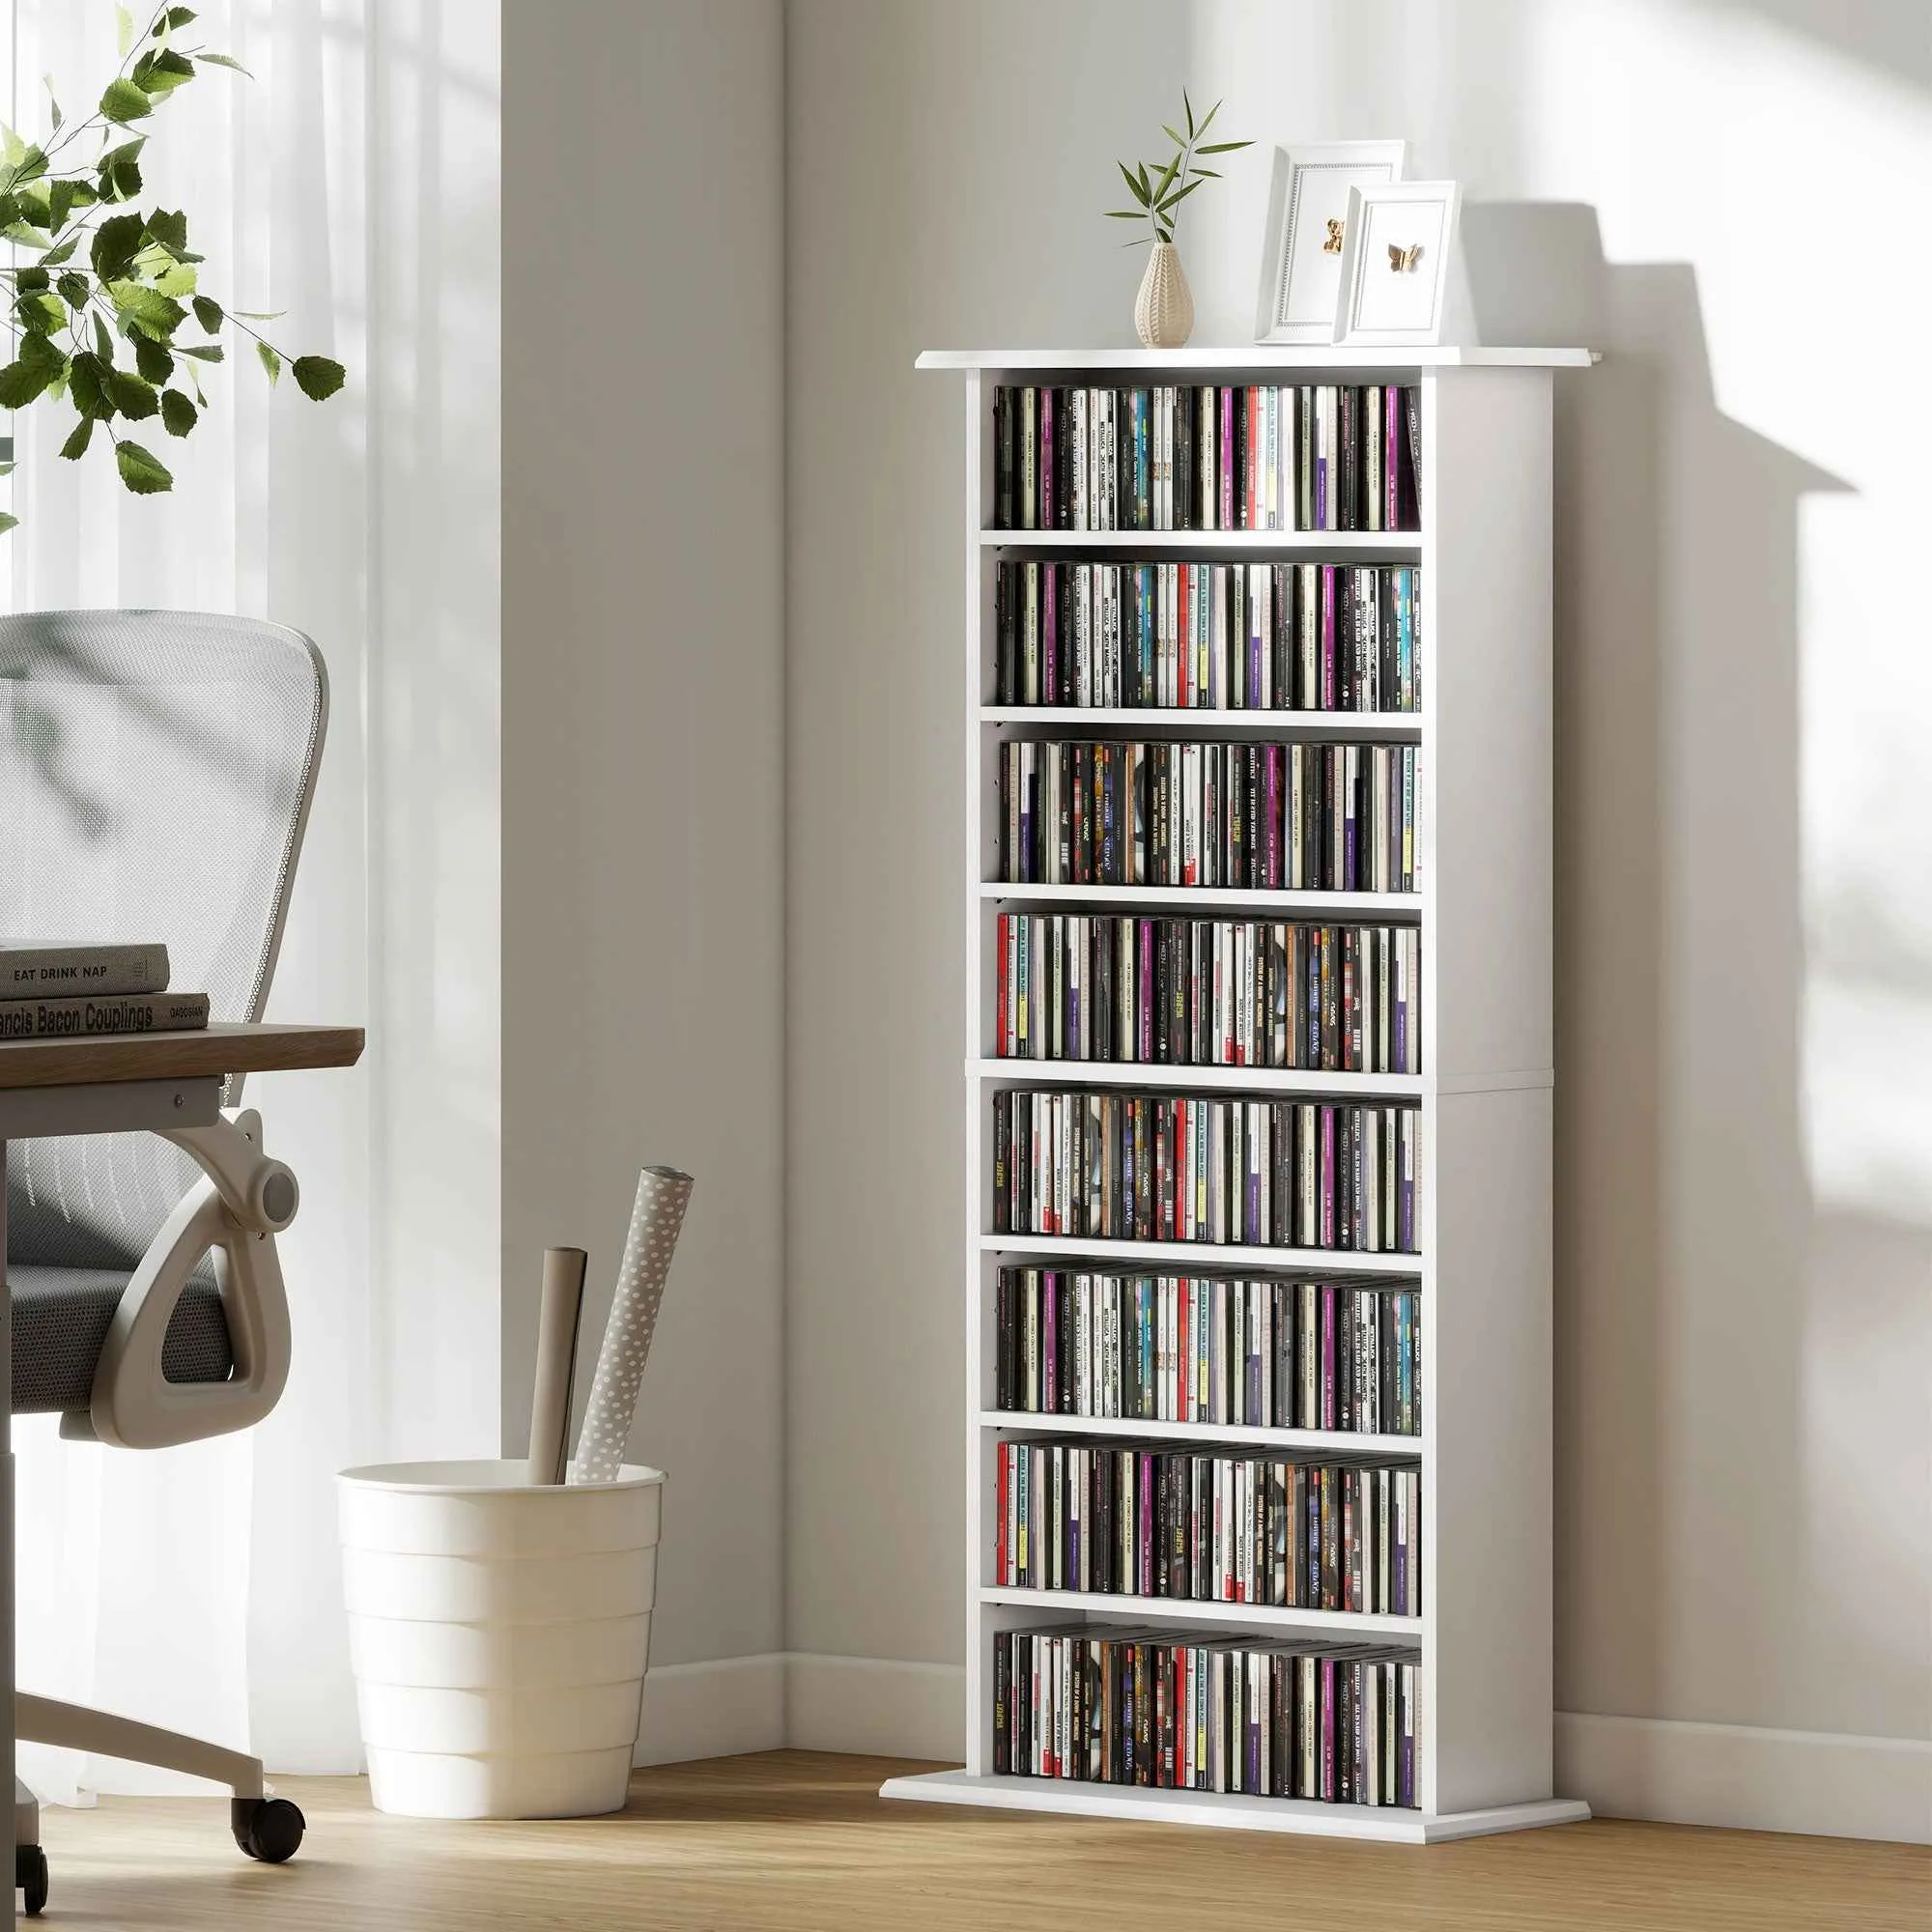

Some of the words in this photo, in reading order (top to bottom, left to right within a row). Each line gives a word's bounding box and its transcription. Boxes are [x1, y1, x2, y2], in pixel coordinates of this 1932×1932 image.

[14, 970, 36, 981] EAT
[41, 968, 77, 980] DRINK
[82, 966, 107, 978] NAP
[38, 1005, 80, 1032] Bacon
[85, 1001, 153, 1033] Couplings
